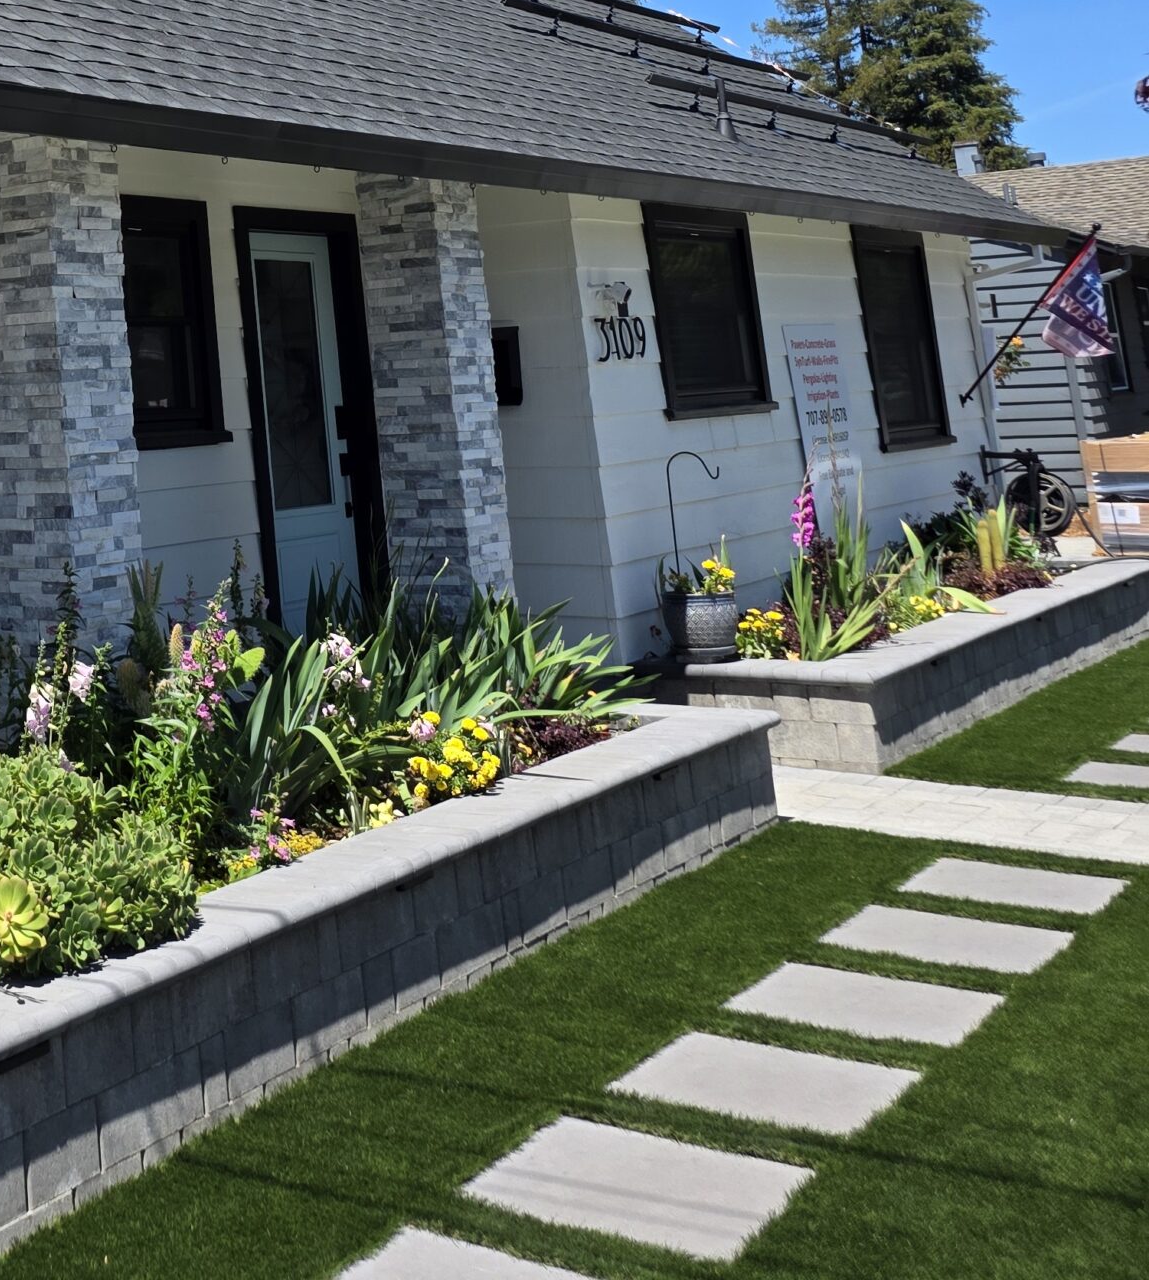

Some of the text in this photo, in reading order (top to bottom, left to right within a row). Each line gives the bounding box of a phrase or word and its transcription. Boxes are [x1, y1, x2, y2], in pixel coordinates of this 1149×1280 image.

[1060, 293, 1089, 321] WE
[594, 315, 646, 362] 3109
[805, 407, 848, 426] 707-89-0578
